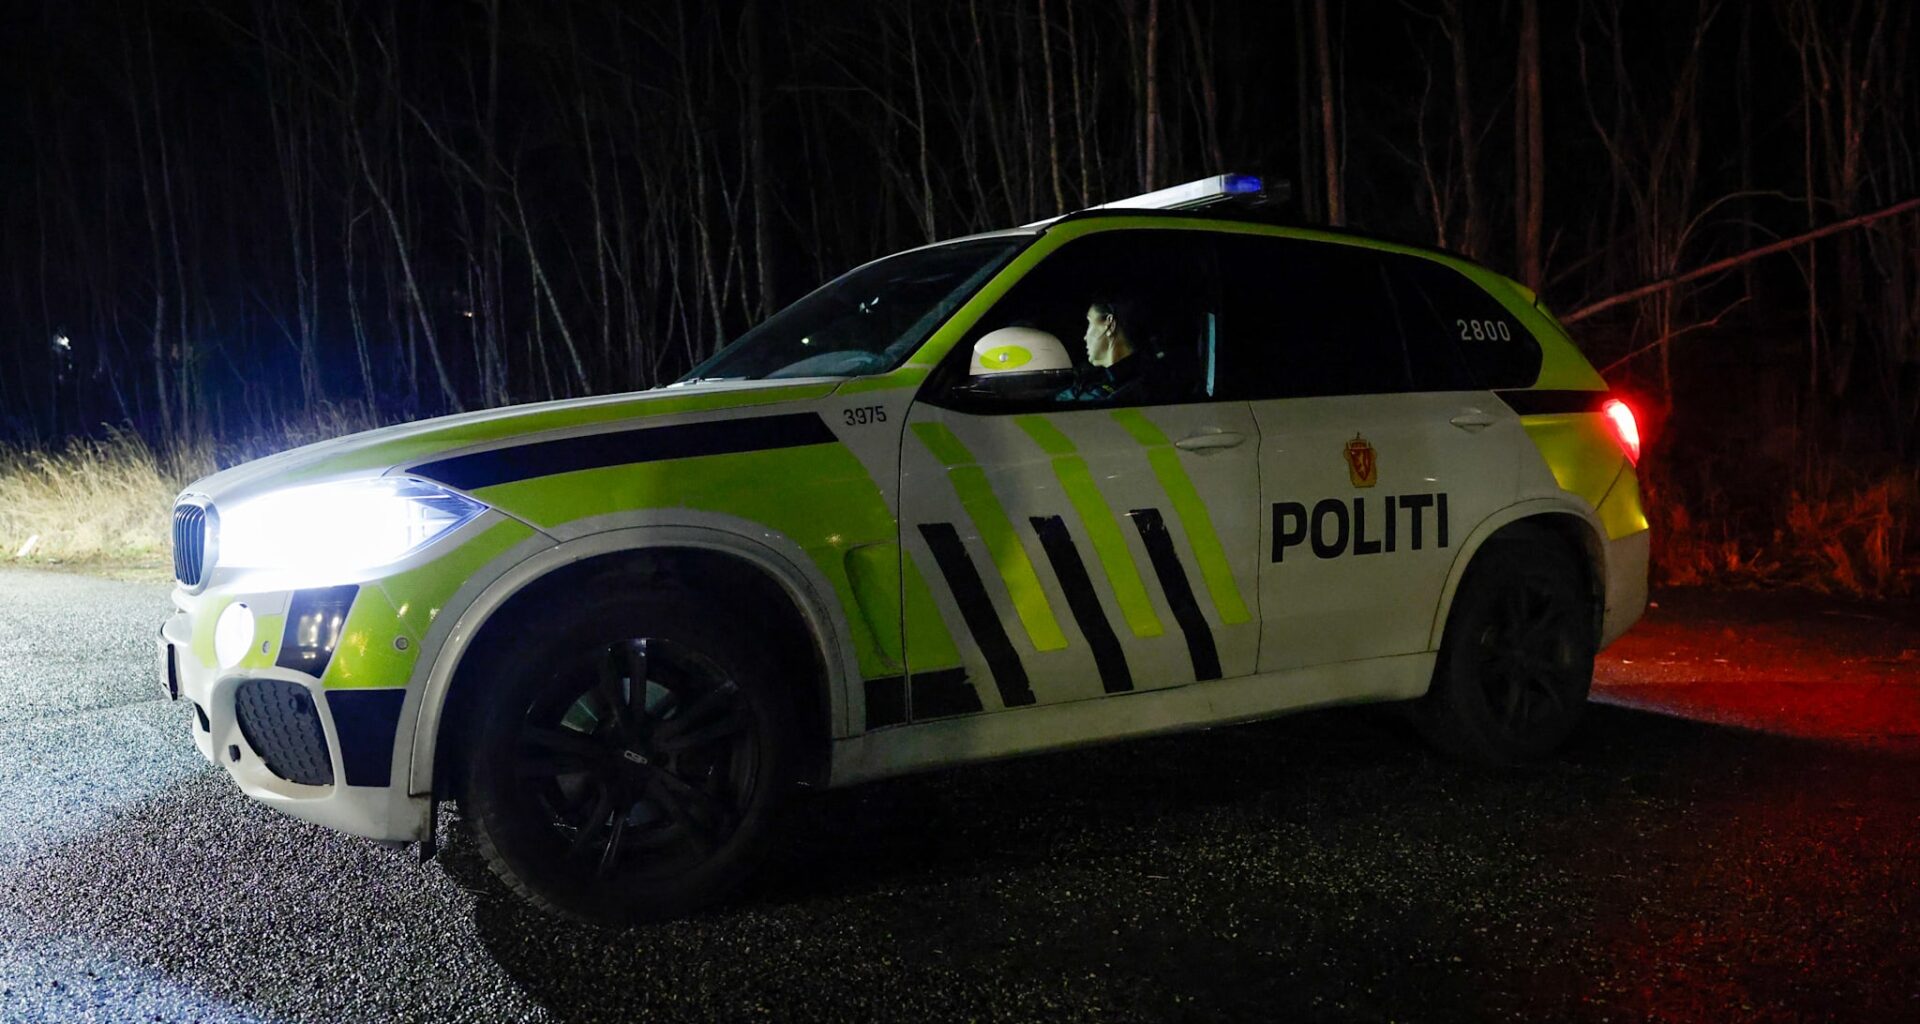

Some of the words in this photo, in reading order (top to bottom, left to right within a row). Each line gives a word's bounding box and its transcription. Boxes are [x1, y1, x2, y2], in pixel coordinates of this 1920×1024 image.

[1457, 319, 1511, 341] 2800
[843, 406, 887, 425] 3975
[1272, 494, 1448, 562] POLITI
